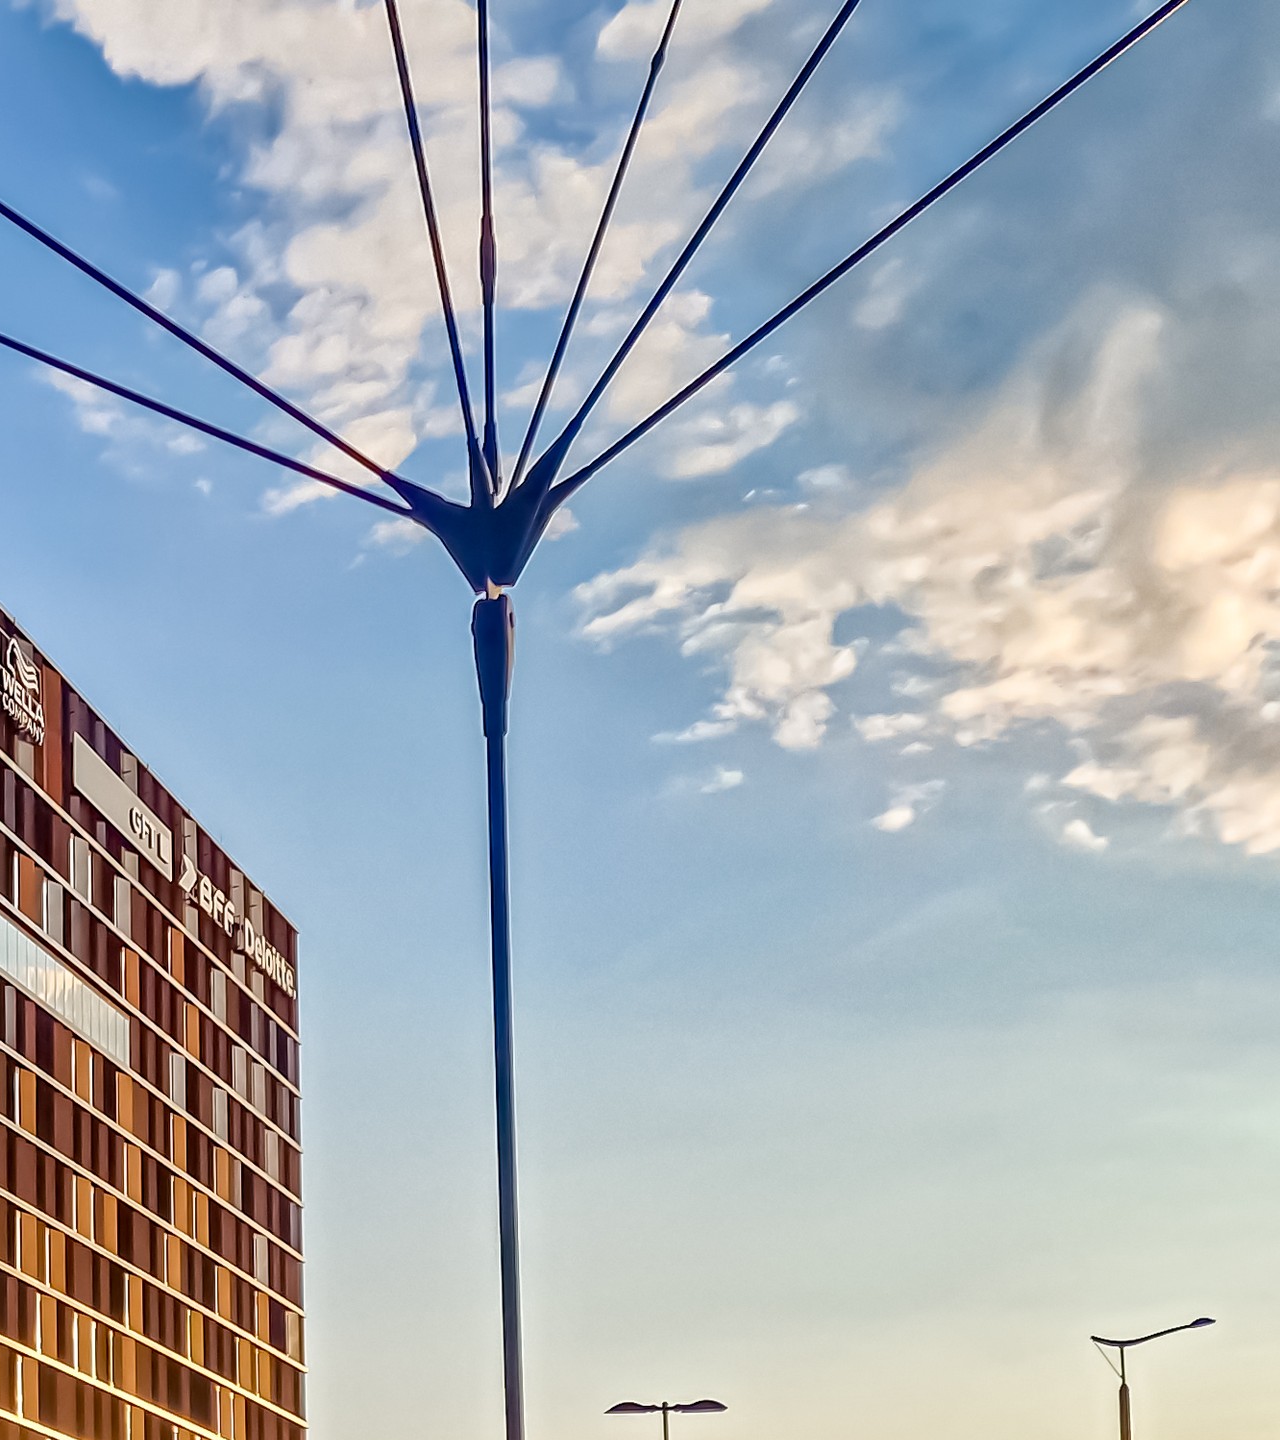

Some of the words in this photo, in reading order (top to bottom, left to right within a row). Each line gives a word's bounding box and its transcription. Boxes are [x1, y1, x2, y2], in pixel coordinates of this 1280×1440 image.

[2, 667, 45, 728] WELLA
[2, 692, 45, 746] COMPANY
[199, 874, 235, 938] BFF
